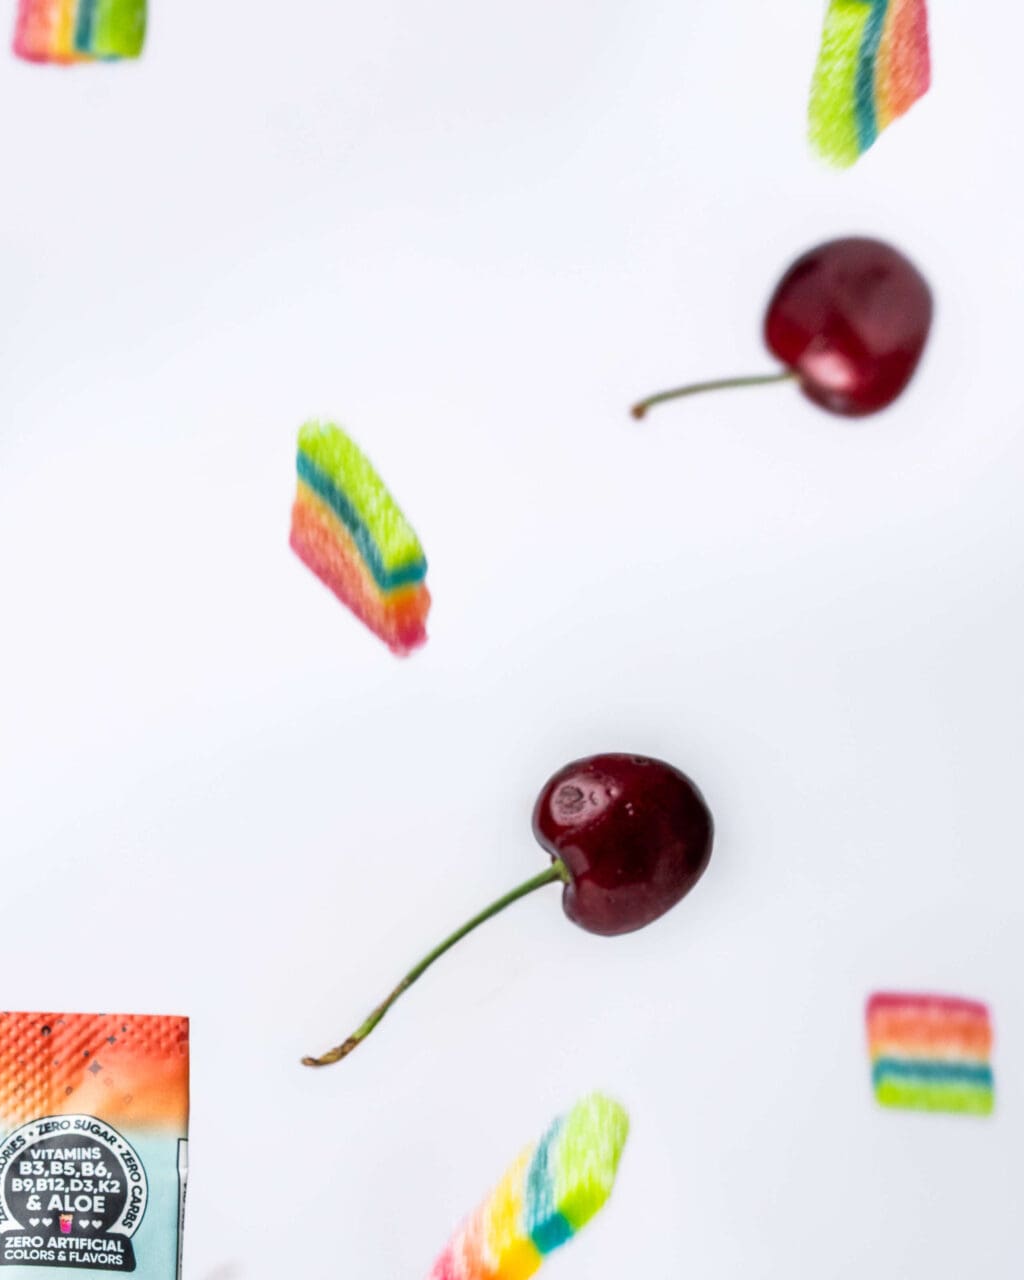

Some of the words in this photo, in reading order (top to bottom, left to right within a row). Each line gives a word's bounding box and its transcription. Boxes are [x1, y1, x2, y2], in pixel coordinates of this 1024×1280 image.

[36, 1120, 71, 1136] ZERO
[73, 1119, 118, 1146] SUGAR
[30, 1146, 102, 1161] VITAMINS
[19, 1161, 113, 1178] B3,B5,B6,
[119, 1149, 142, 1184] ZERO
[11, 1178, 121, 1194] B9,B12,D3,K2
[26, 1195, 42, 1211] &
[47, 1195, 106, 1214] ALOE
[121, 1184, 143, 1229] CARBS
[4, 1236, 44, 1249] ZERO
[46, 1237, 125, 1254] ARTIFICIAL
[4, 1249, 56, 1262] COLORS
[56, 1250, 68, 1262] &
[68, 1251, 124, 1266] FLAVORS
